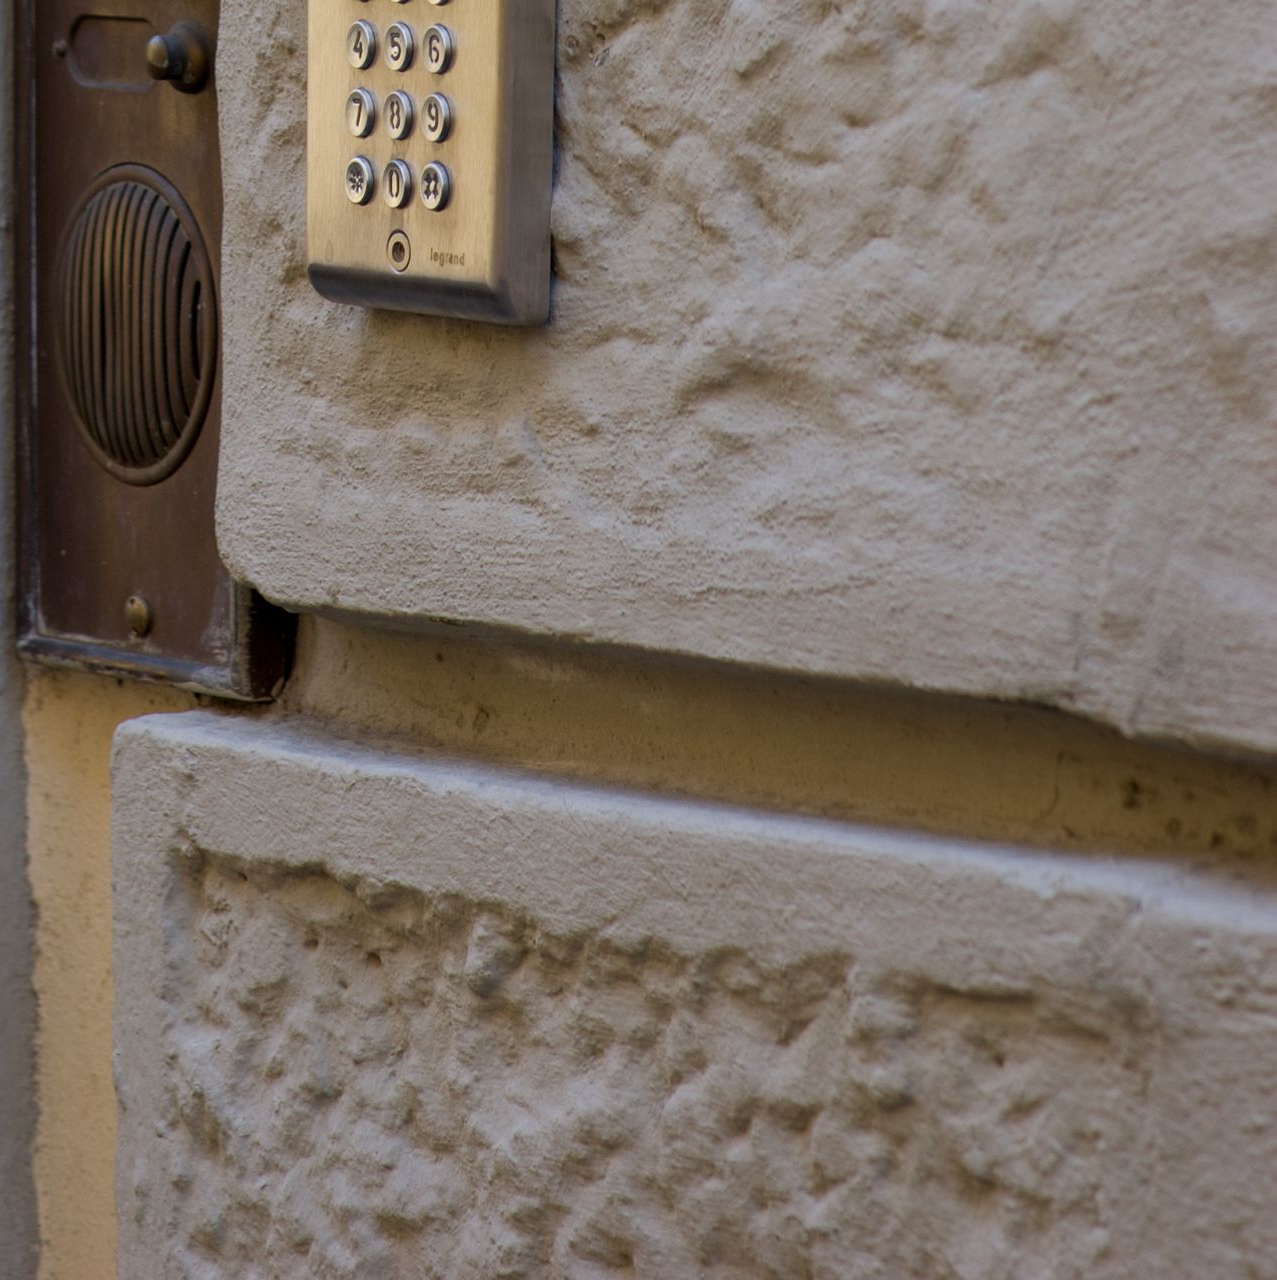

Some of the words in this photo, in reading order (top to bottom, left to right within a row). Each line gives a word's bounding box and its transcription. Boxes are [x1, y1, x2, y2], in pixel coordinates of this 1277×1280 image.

[353, 30, 363, 60] 4
[390, 32, 402, 62] 5
[428, 34, 440, 64] 6
[352, 98, 362, 128] 7
[390, 100, 401, 130] 8
[427, 102, 439, 133] 9
[388, 168, 400, 199] 0
[429, 246, 466, 268] legrand
